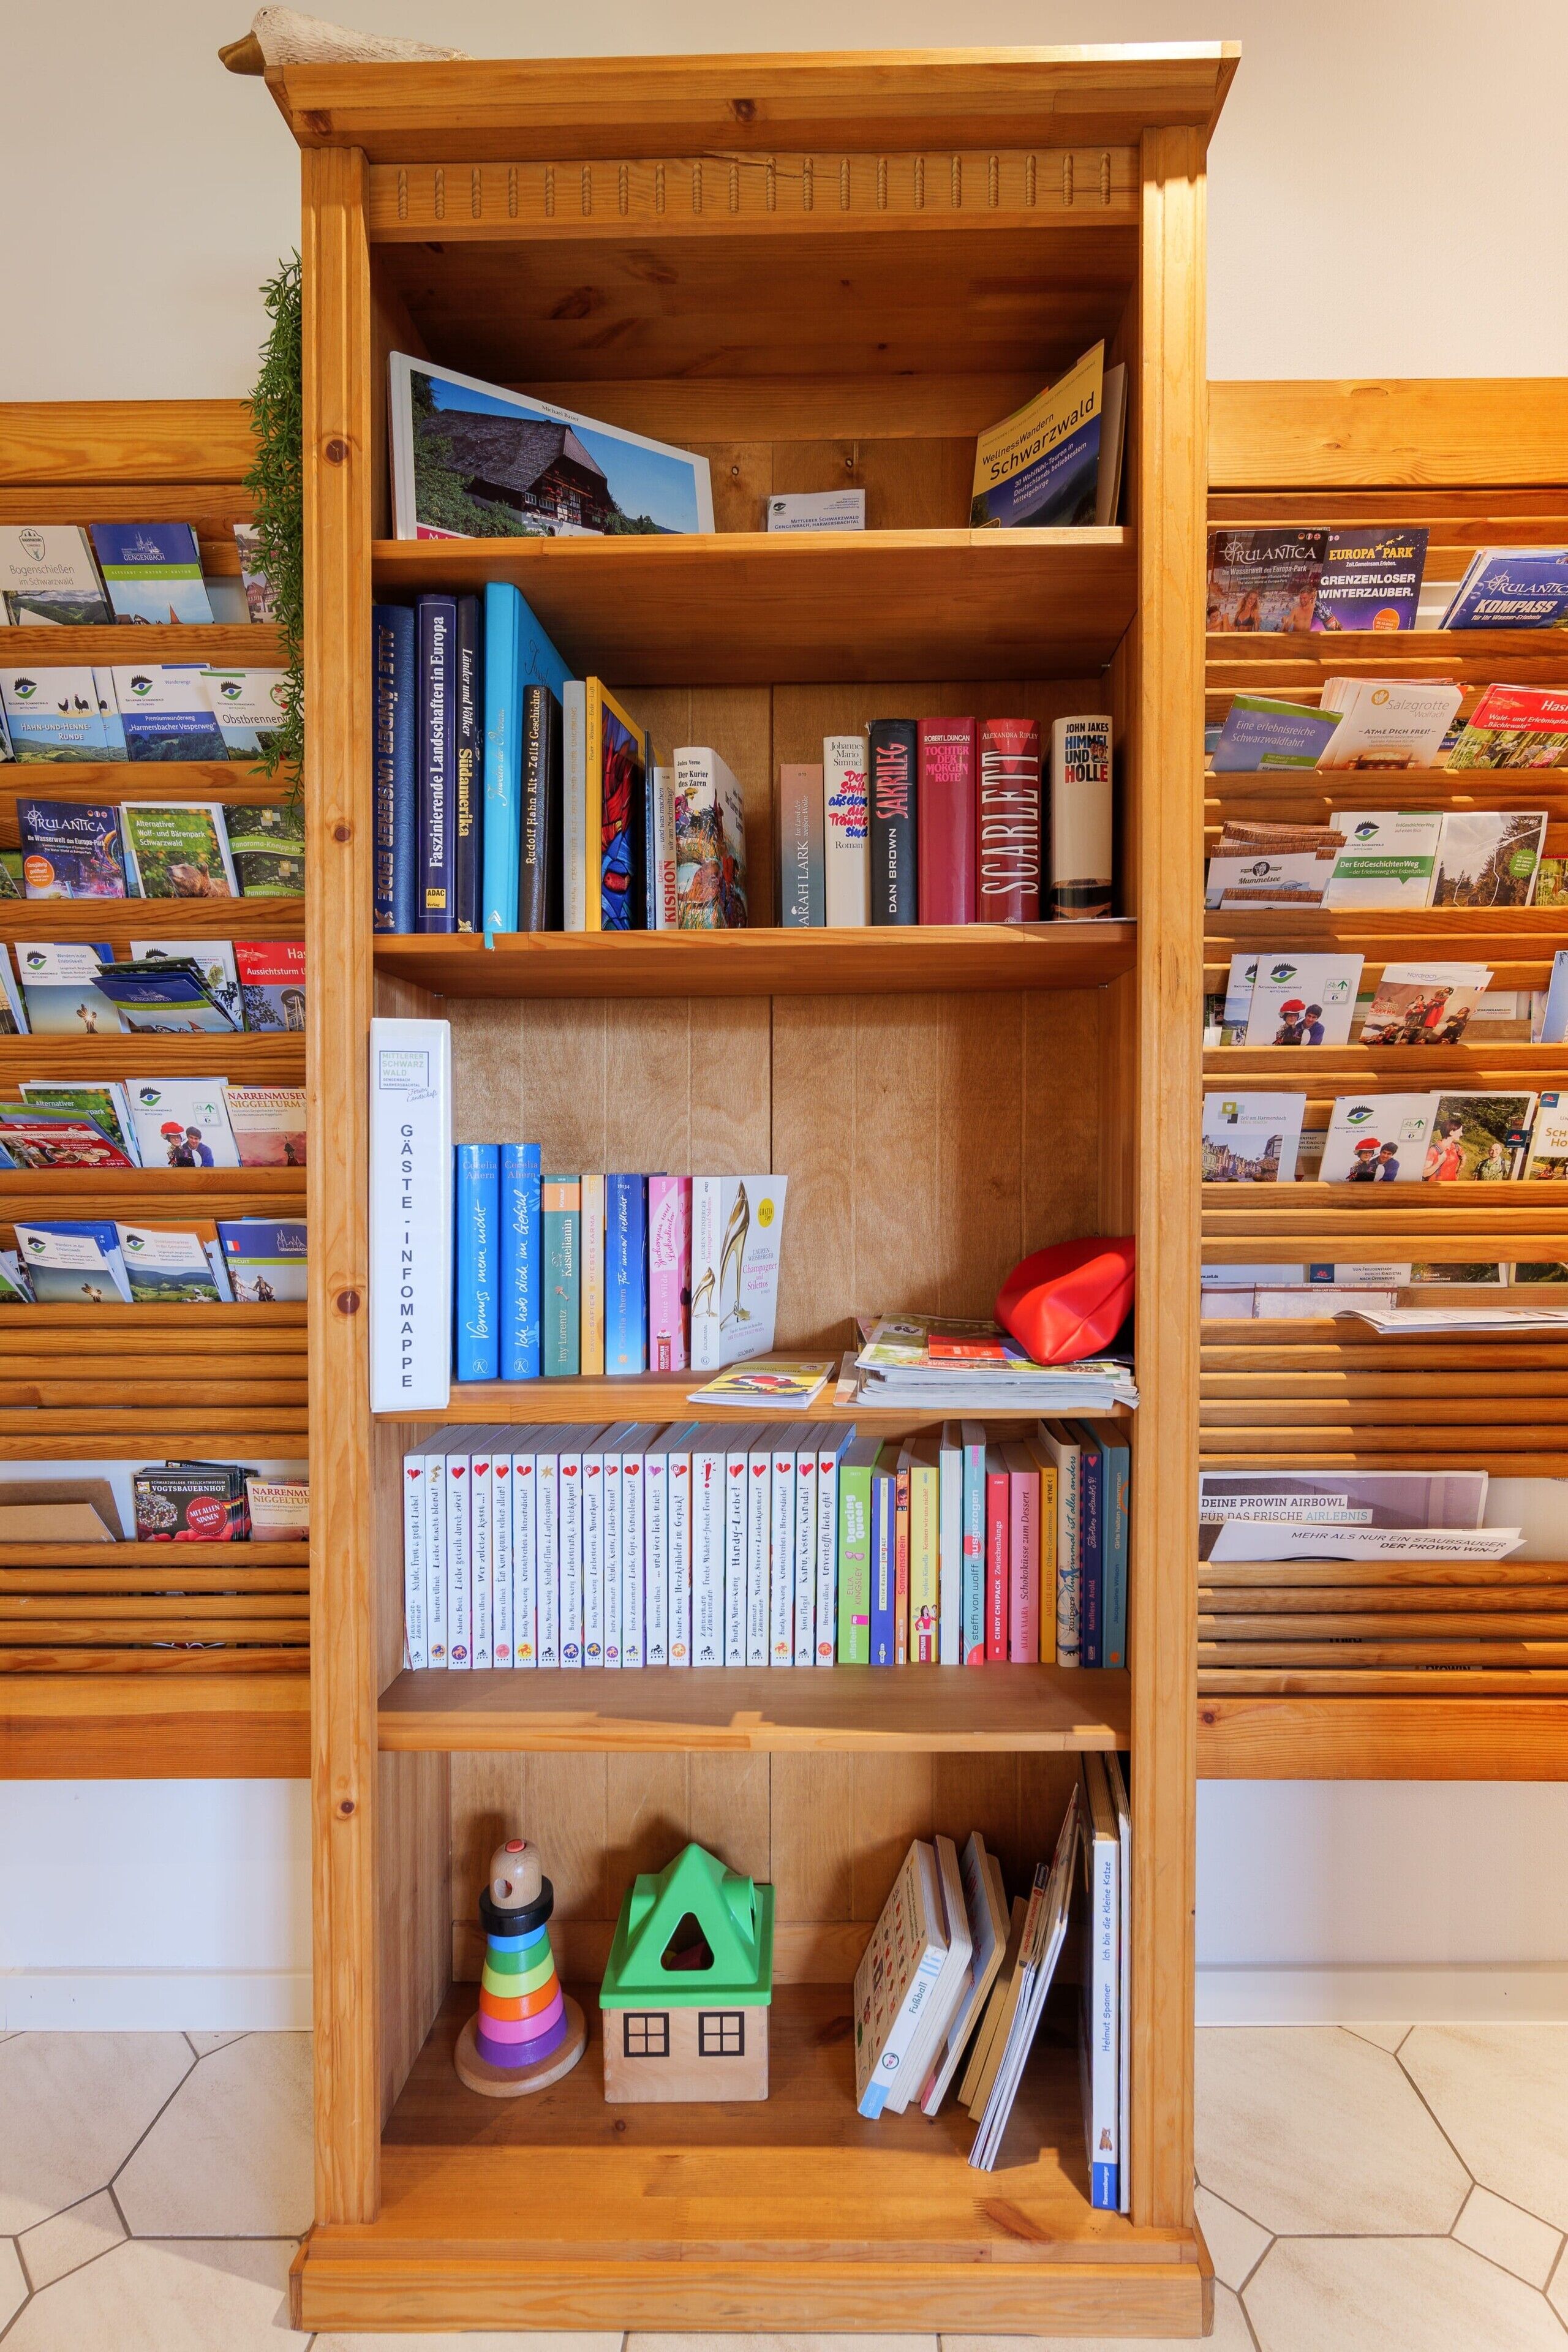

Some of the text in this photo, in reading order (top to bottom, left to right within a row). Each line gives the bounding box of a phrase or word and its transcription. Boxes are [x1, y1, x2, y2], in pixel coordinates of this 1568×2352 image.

[541, 405, 579, 421] Michael Bauer
[982, 413, 1054, 465] WellnessWandern
[990, 391, 1095, 481] Schwarzwald
[1014, 442, 1087, 496] Deutschlands beliebtestem
[1023, 451, 1066, 485] Wohlfühl-Touren
[1013, 479, 1049, 505] Mittelgebirge
[1232, 543, 1316, 563] RULANTICA
[1329, 547, 1413, 560] EUROPA PARK
[9, 565, 75, 576] Bogenschießen
[1321, 574, 1415, 586] GRENZENLOSER
[1319, 587, 1414, 598] WINTERZAUBER.
[1473, 600, 1558, 613] KOMPASS
[462, 649, 473, 736] Länder und Völker
[1385, 699, 1450, 712] Salzgrotte
[982, 731, 1038, 740] ALEXANDRA RIPLEY
[1066, 723, 1109, 733] JOHN JAKES
[1232, 733, 1305, 748] Schwarzwaldfahrt
[1237, 721, 1315, 737] Eine erlebnisreiche
[429, 616, 444, 868] Faszinierende Landschaften in Europa
[378, 625, 399, 901] ALLE LÄNDER UNSERER ERDE
[459, 748, 472, 837] Südamerika
[876, 742, 908, 819] SAKRILEG
[34, 817, 107, 833] RULANTICA
[981, 750, 1038, 894] SCARLETT
[665, 861, 675, 924] KISHON
[1237, 876, 1281, 884] Mummelsee
[562, 1219, 572, 1277] Kastellanin
[618, 1194, 630, 1286] Für immer vielleicht
[467, 1200, 490, 1339] Vermiss mein nicht
[513, 1189, 529, 1348] Ich hab dich im Gefühl
[559, 1350, 567, 1362] Iny
[202, 1505, 220, 1514] ALLEN
[1200, 1510, 1368, 1521] FÜR DAS FRISCHE AIRLEBNIS
[1201, 1498, 1344, 1507] DEINE PROWIN AIRBOWL
[197, 1513, 219, 1523] SINNEN
[731, 1487, 743, 1566] Handy-Liebe!
[846, 1495, 856, 1543] Dancing
[971, 1490, 981, 1558] ausgezogen
[1412, 1537, 1507, 1547] STAUBSAUGER
[1020, 1546, 1029, 1600] Schokoküsse
[1102, 1861, 1111, 1885] Katze
[909, 1981, 927, 2014] Fußball
[1103, 1983, 1112, 2018] Spanner
